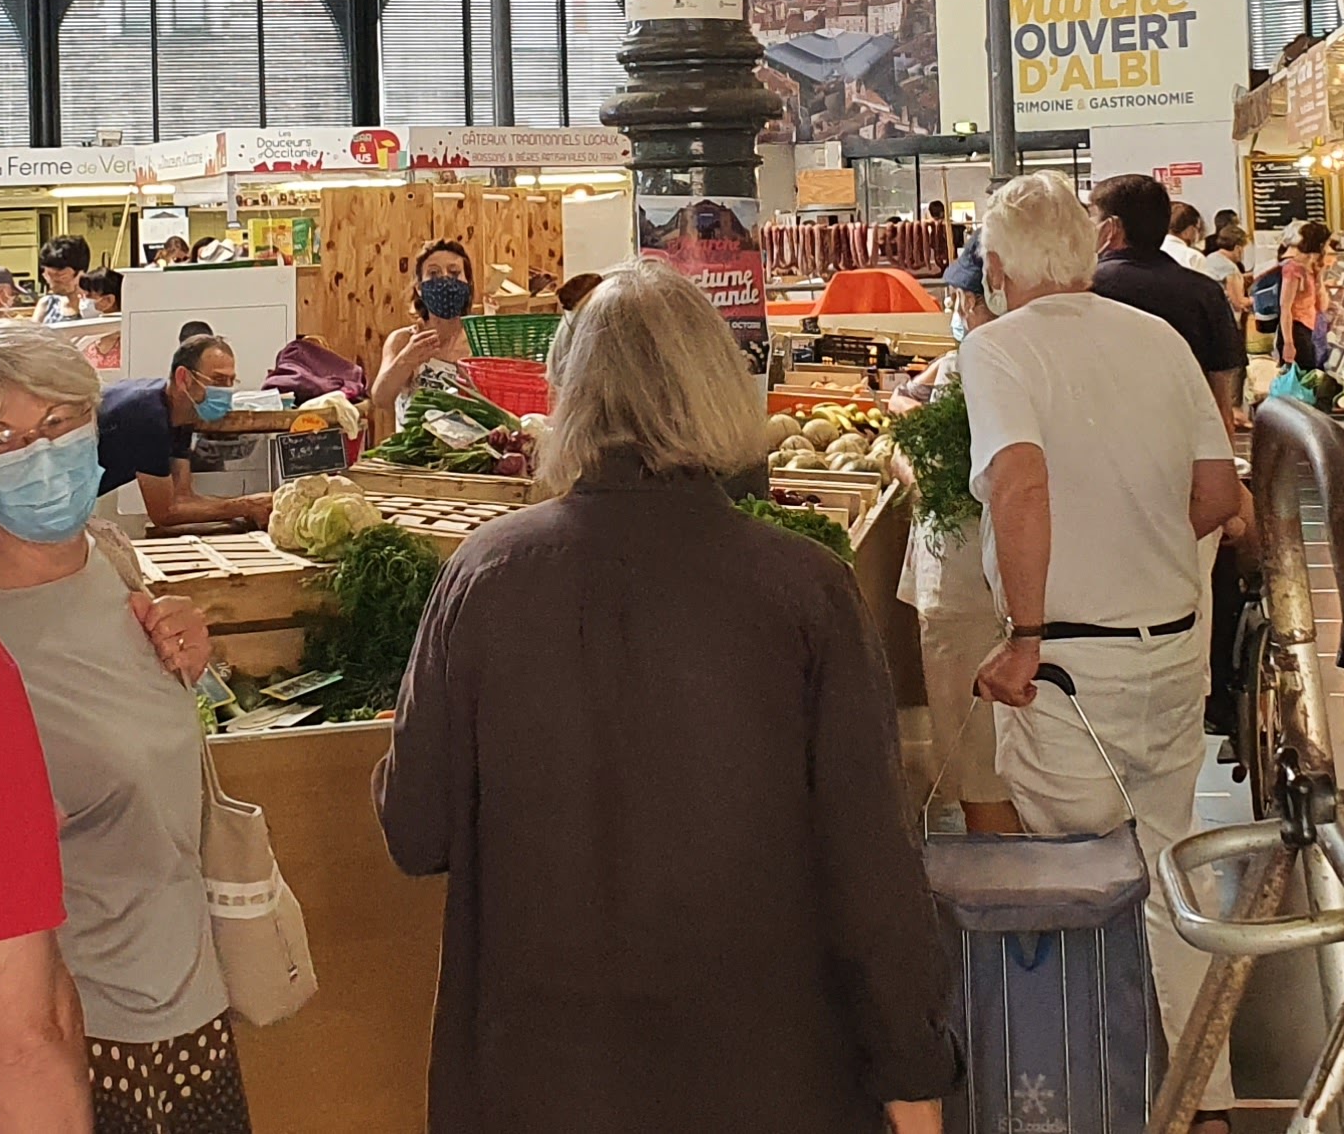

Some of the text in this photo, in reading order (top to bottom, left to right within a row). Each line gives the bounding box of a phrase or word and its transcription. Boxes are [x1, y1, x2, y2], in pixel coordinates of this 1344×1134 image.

[1014, 11, 1197, 59] OUVERT
[1018, 50, 1161, 94] D'ALBI
[1013, 99, 1074, 114] RIMOINE
[1089, 92, 1195, 110] GASTRONOMIE
[256, 137, 312, 149] Douceurs
[462, 130, 507, 146] GÂTEAUX
[583, 133, 619, 146] LOCAUX
[7, 156, 73, 176] Ferme
[76, 161, 97, 175] de
